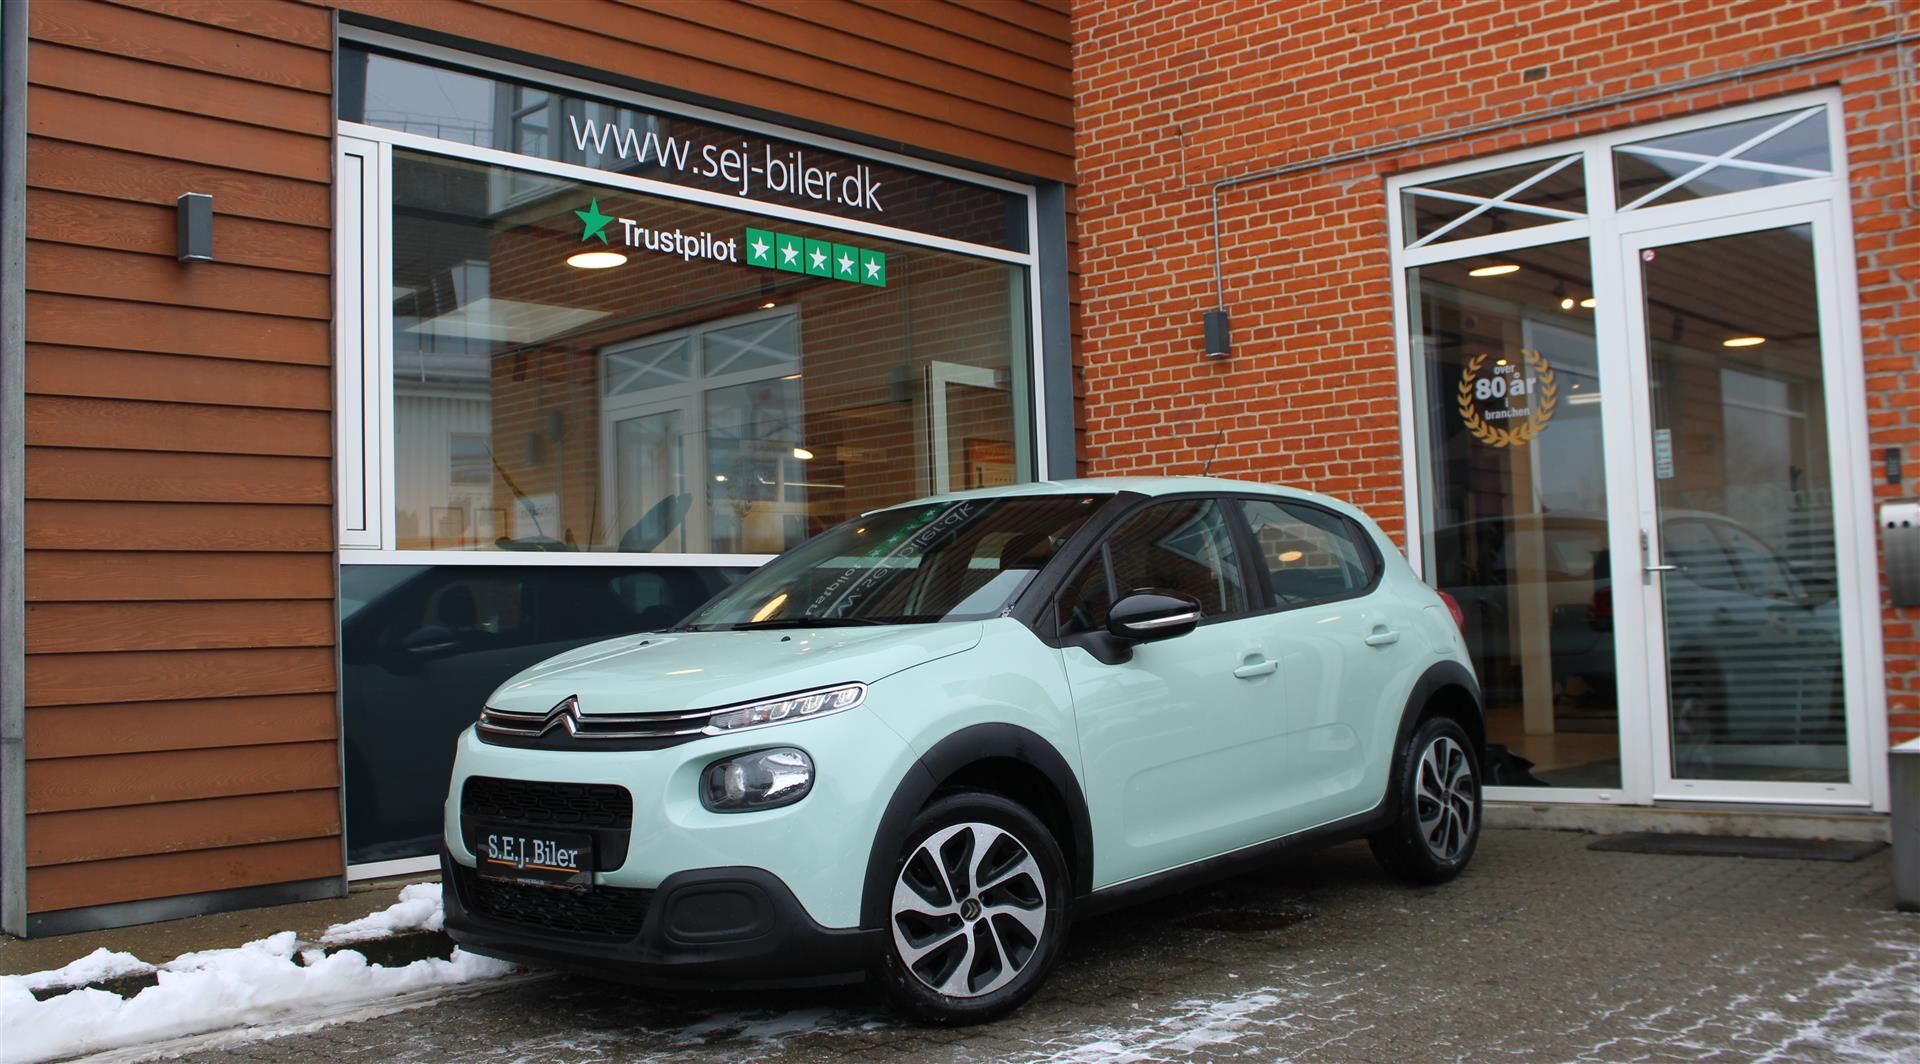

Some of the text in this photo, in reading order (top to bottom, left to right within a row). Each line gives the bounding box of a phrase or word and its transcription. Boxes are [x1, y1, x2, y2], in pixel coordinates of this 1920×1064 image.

[570, 115, 884, 212] www.sej-biler.dk
[618, 217, 738, 263] Trustpilot
[1493, 364, 1516, 375] over
[1475, 371, 1537, 400] 80 år
[1484, 407, 1530, 420] branchen
[488, 834, 578, 868] S.E.J. Biler
